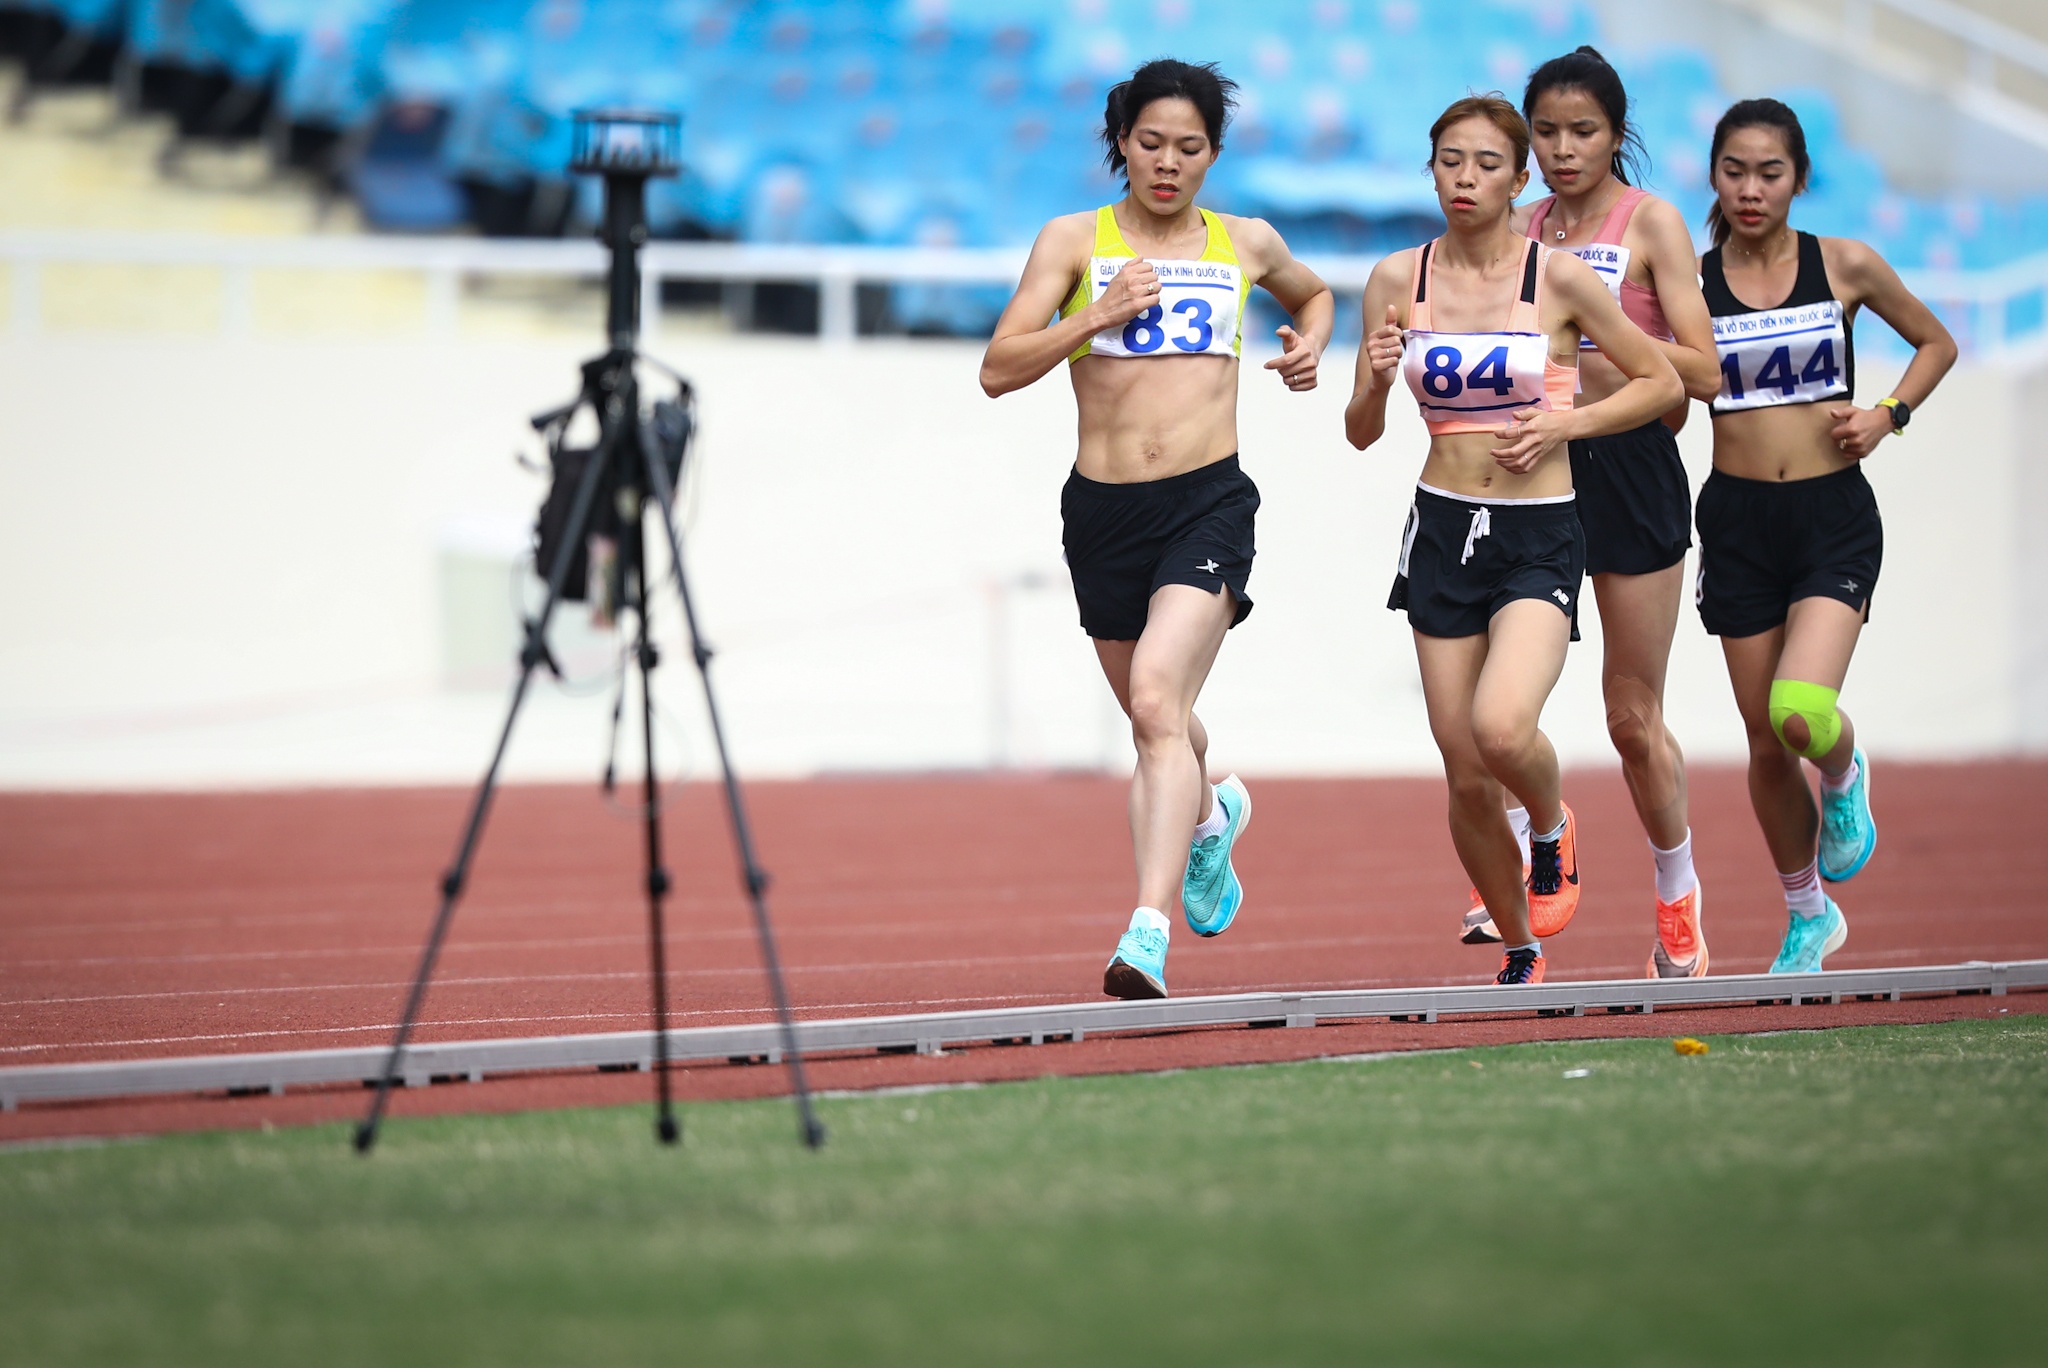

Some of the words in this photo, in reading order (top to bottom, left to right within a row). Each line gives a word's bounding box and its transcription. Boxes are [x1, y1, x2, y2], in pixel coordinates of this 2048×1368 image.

[1175, 266, 1193, 277] KINH
[1220, 270, 1232, 280] GIA
[1606, 251, 1617, 263] GIA
[1123, 298, 1213, 353] 83
[1779, 315, 1797, 327] KINH
[1822, 308, 1834, 319] GIA
[1422, 345, 1514, 399] 84
[1721, 338, 1840, 400] 144
